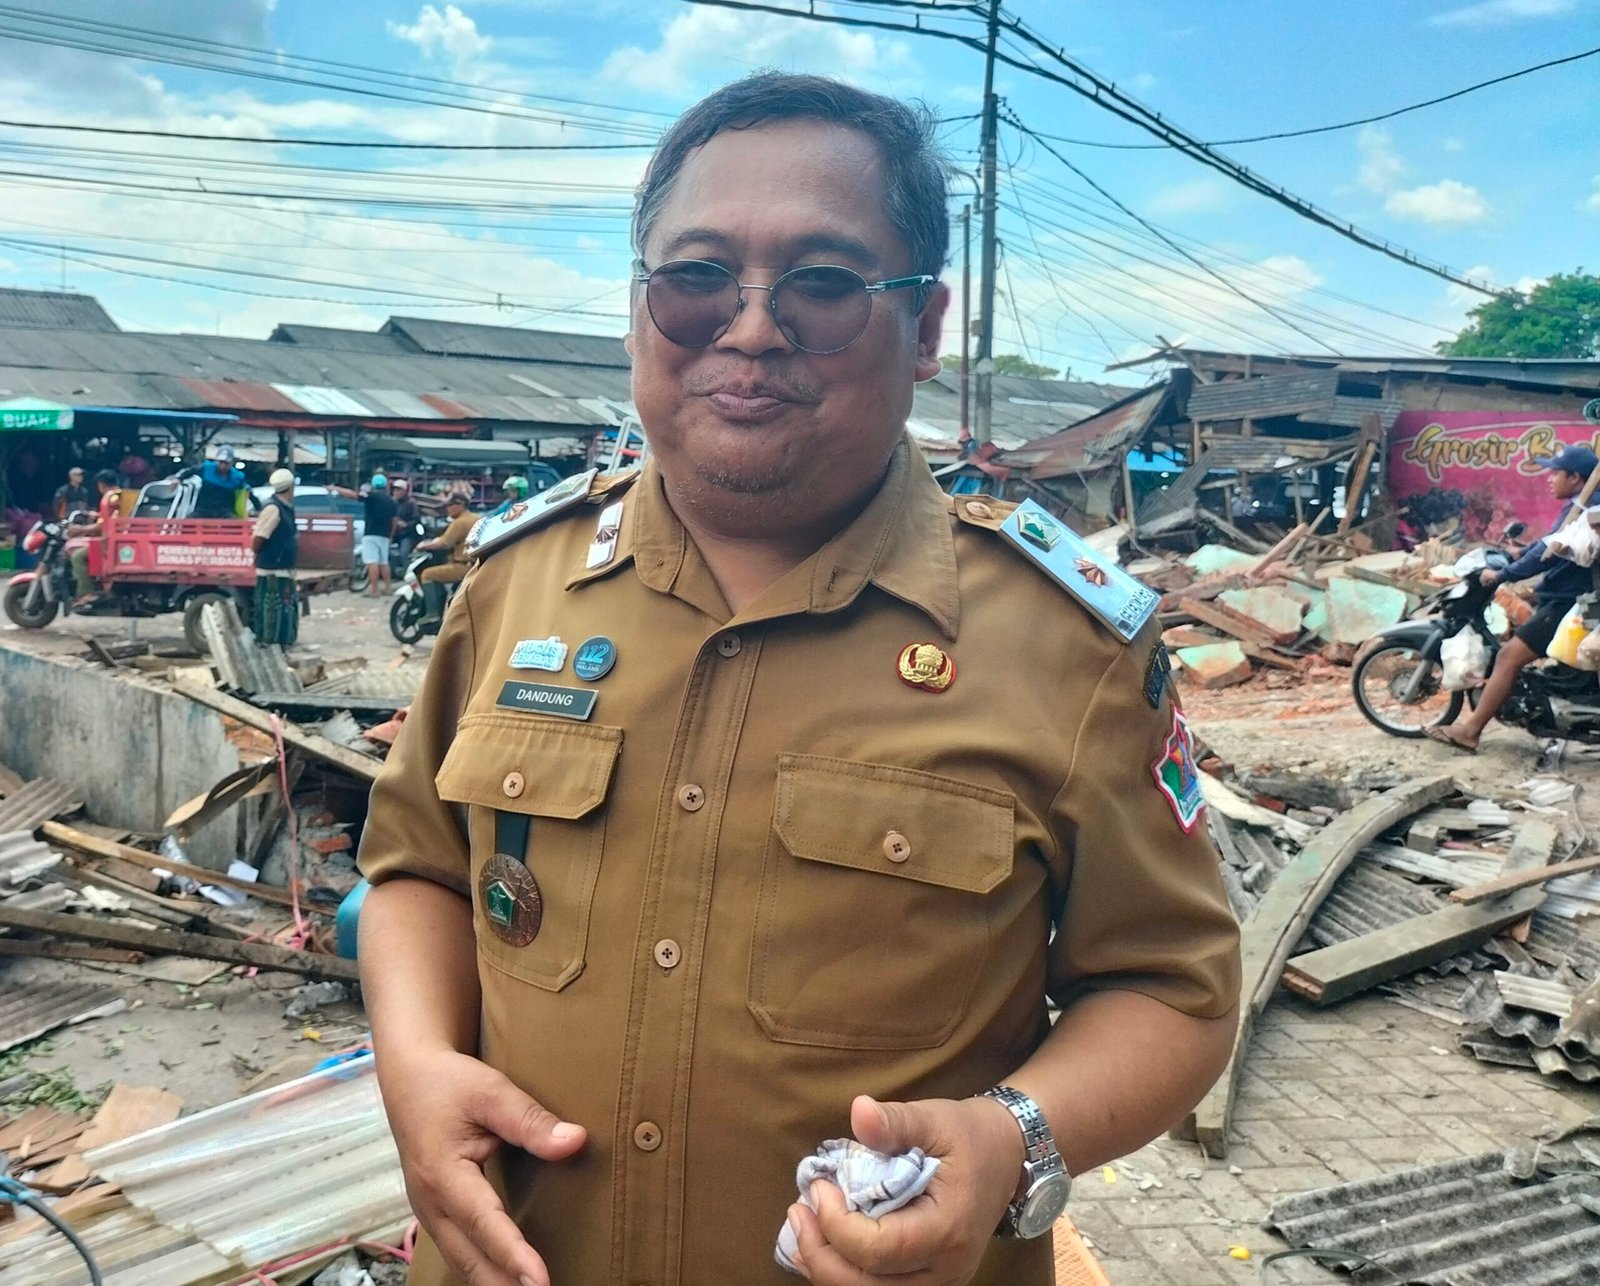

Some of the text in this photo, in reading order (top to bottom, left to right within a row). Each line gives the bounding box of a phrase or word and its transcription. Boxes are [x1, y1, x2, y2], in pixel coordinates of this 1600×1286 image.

[1404, 424, 1518, 479] Grosir
[217, 546, 242, 556] KOTA
[157, 555, 193, 565] DINAS
[579, 644, 610, 664] 112
[516, 689, 574, 706] DANDUNG
